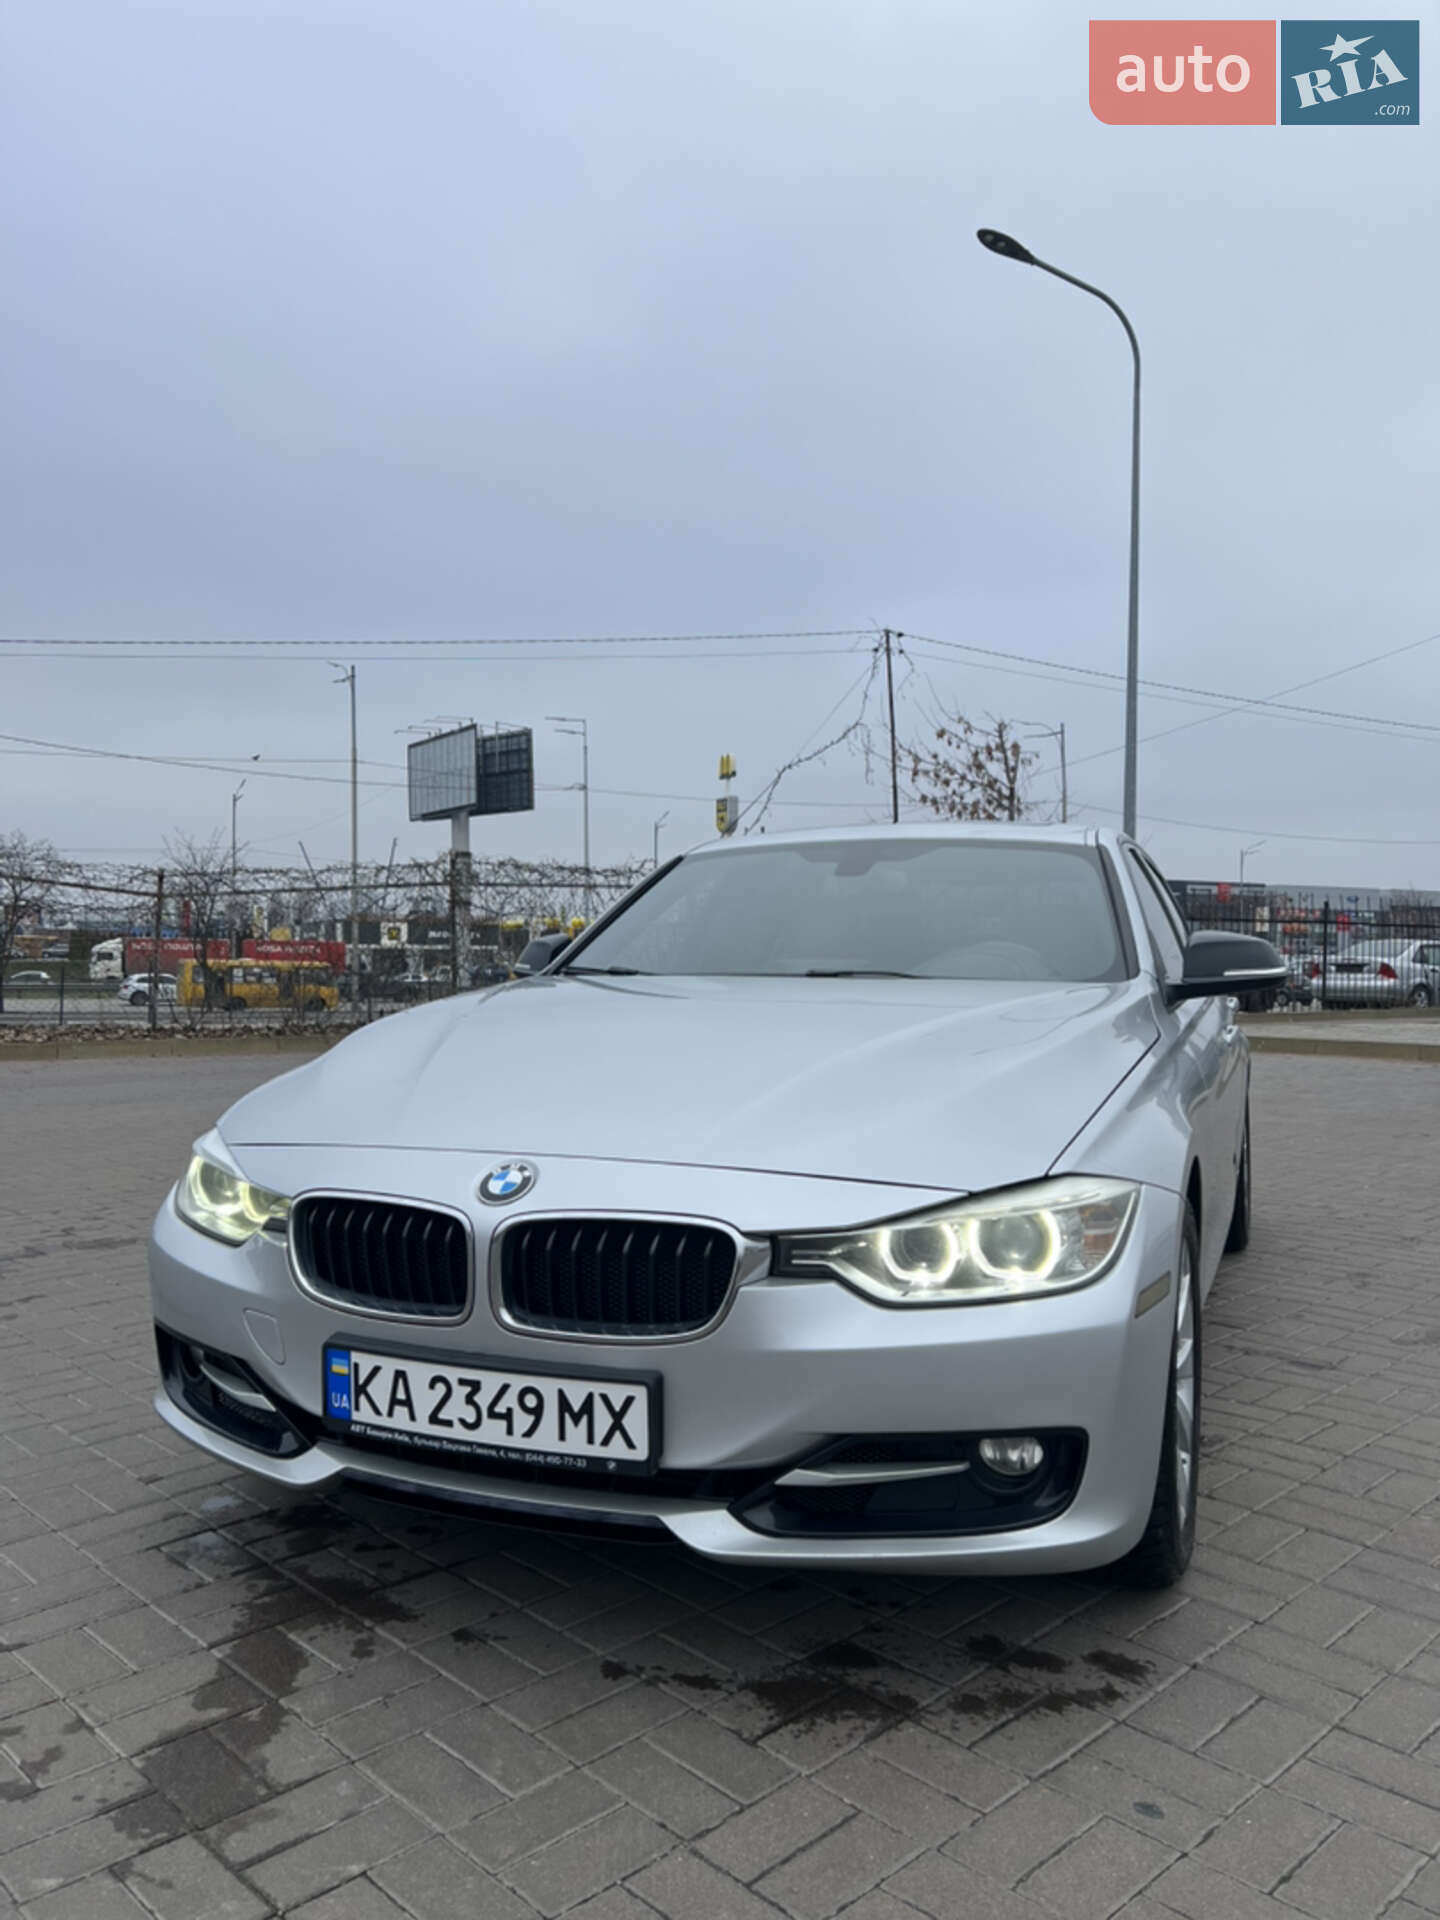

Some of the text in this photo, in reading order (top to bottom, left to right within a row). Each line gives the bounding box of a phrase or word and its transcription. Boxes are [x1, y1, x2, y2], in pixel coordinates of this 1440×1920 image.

[331, 1391, 350, 1409] UA
[352, 1361, 637, 1451] KA 2349 MX
